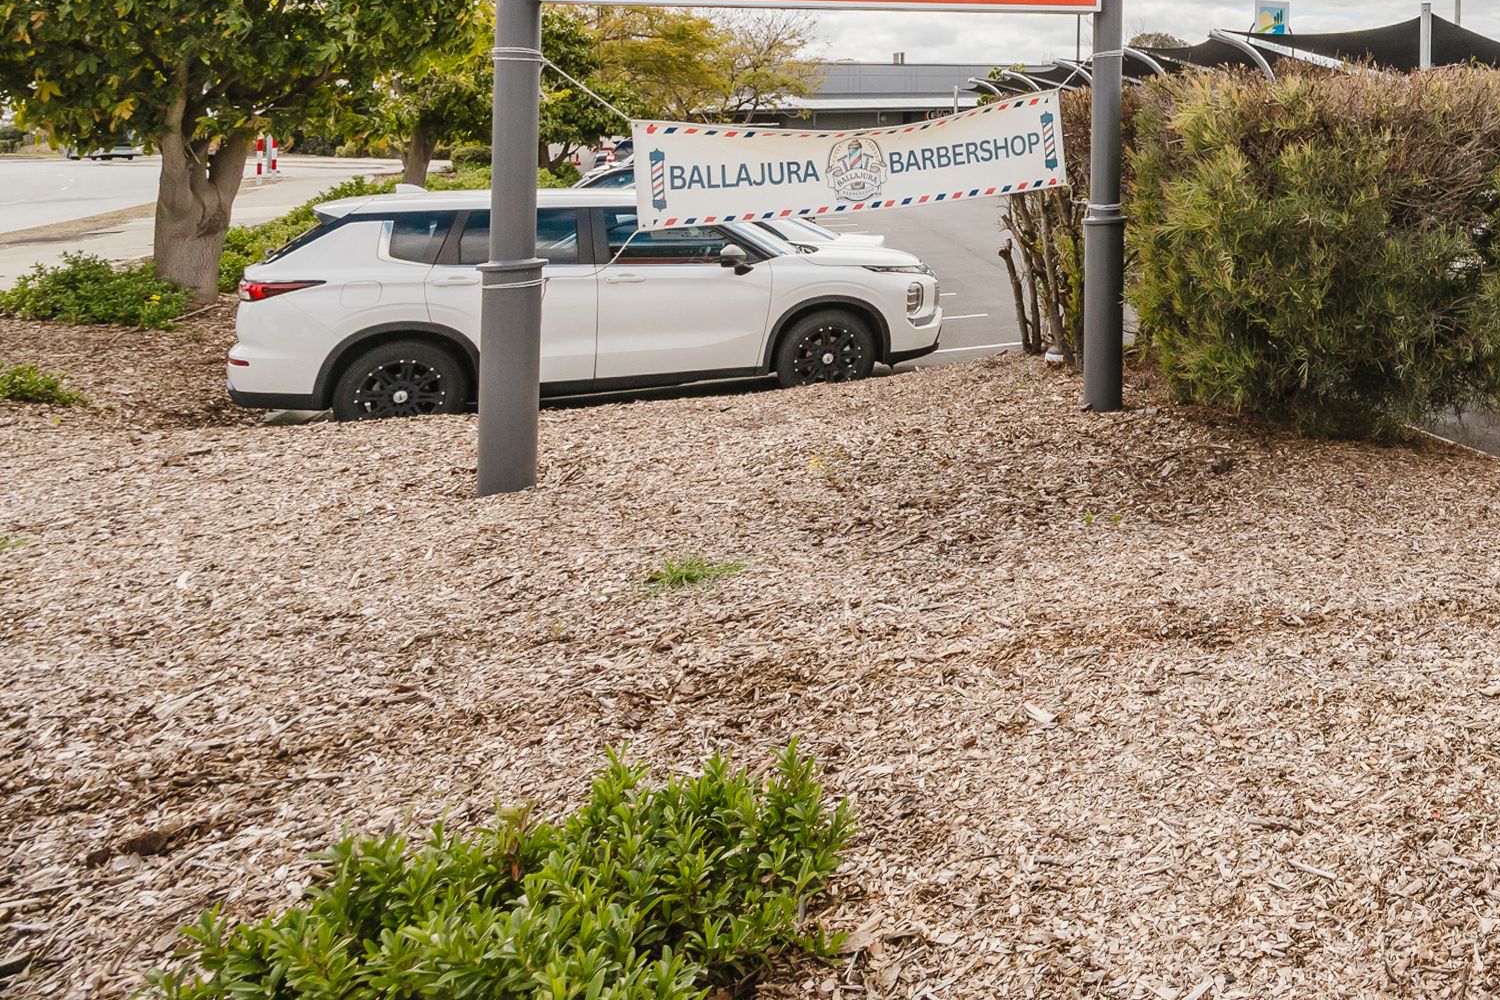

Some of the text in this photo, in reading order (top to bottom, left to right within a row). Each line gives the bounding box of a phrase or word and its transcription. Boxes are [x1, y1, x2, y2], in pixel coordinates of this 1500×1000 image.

[669, 132, 1040, 190] BALLAJURA BARBERSHOP
[837, 172, 878, 187] BALLAJURA
